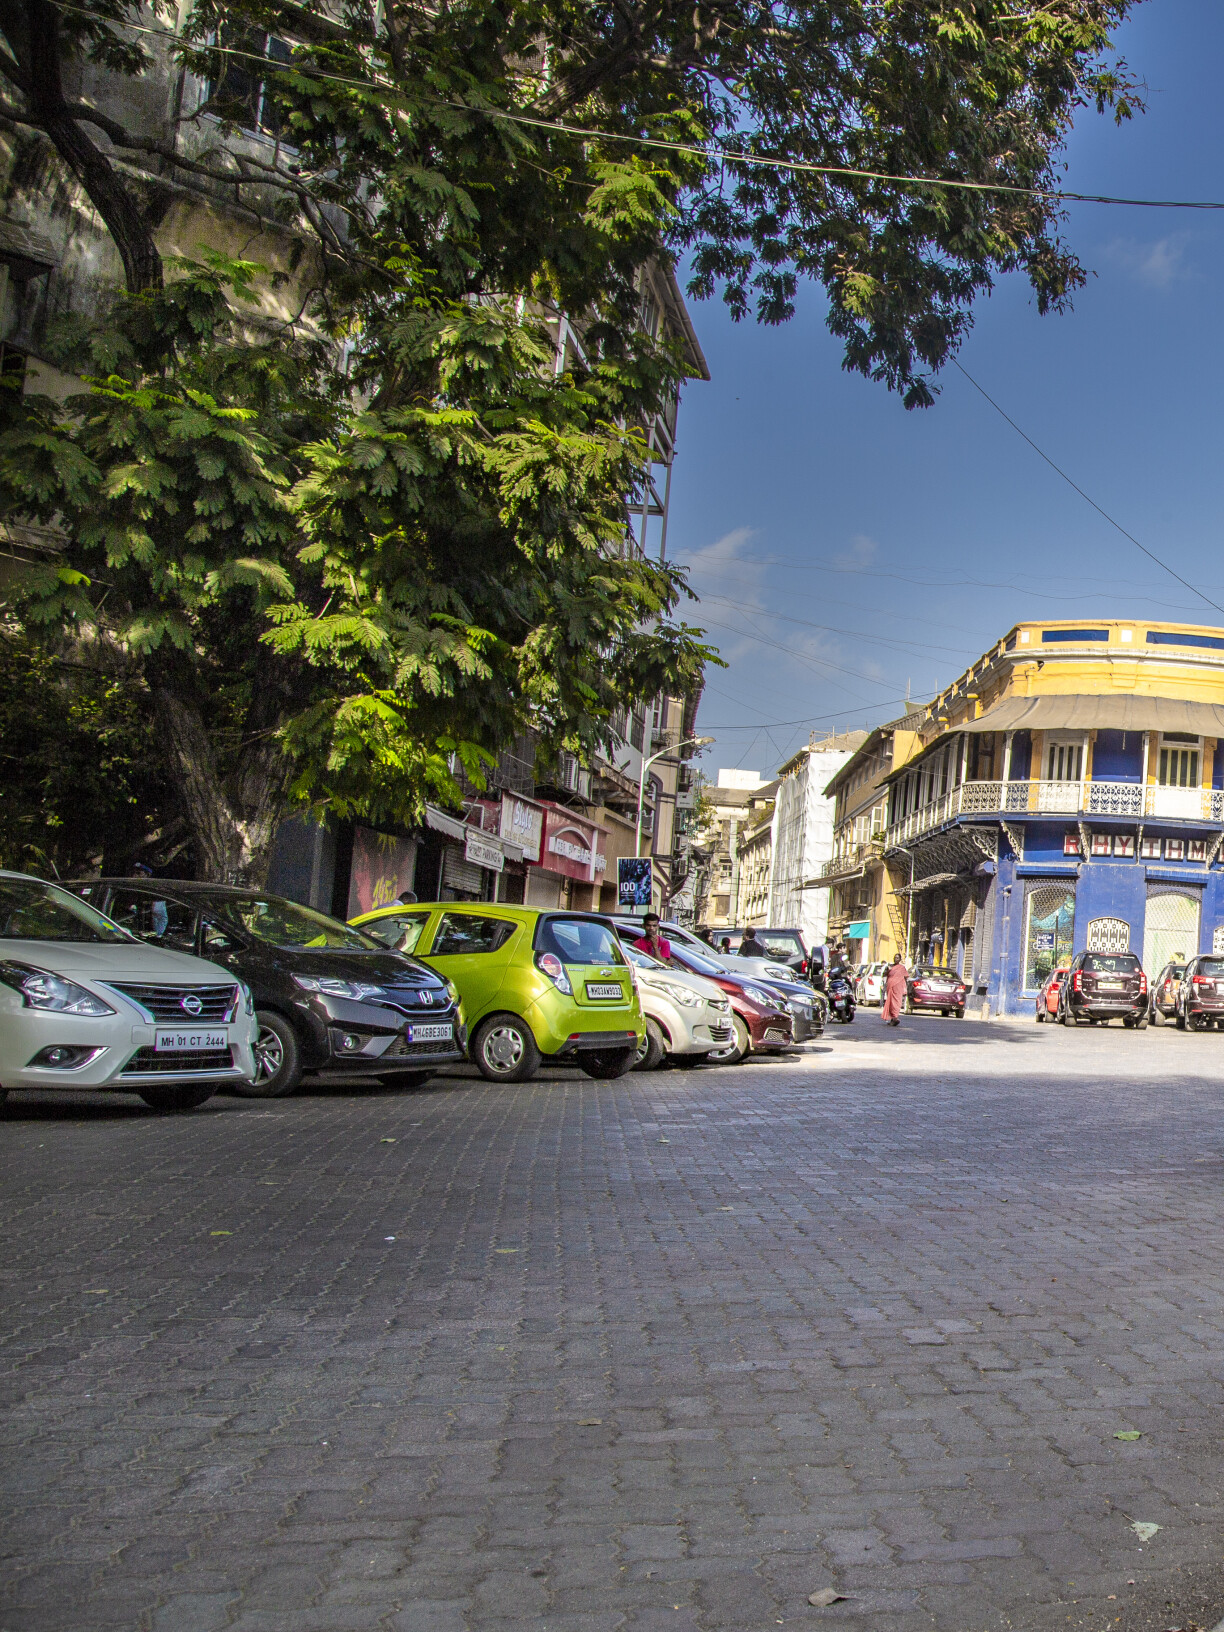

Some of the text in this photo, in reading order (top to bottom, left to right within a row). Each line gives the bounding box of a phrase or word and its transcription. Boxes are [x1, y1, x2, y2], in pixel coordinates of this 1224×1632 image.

[1066, 836, 1206, 860] RHYTHM
[620, 882, 635, 891] 100
[161, 1036, 224, 1046] MH 01 CT 2444
